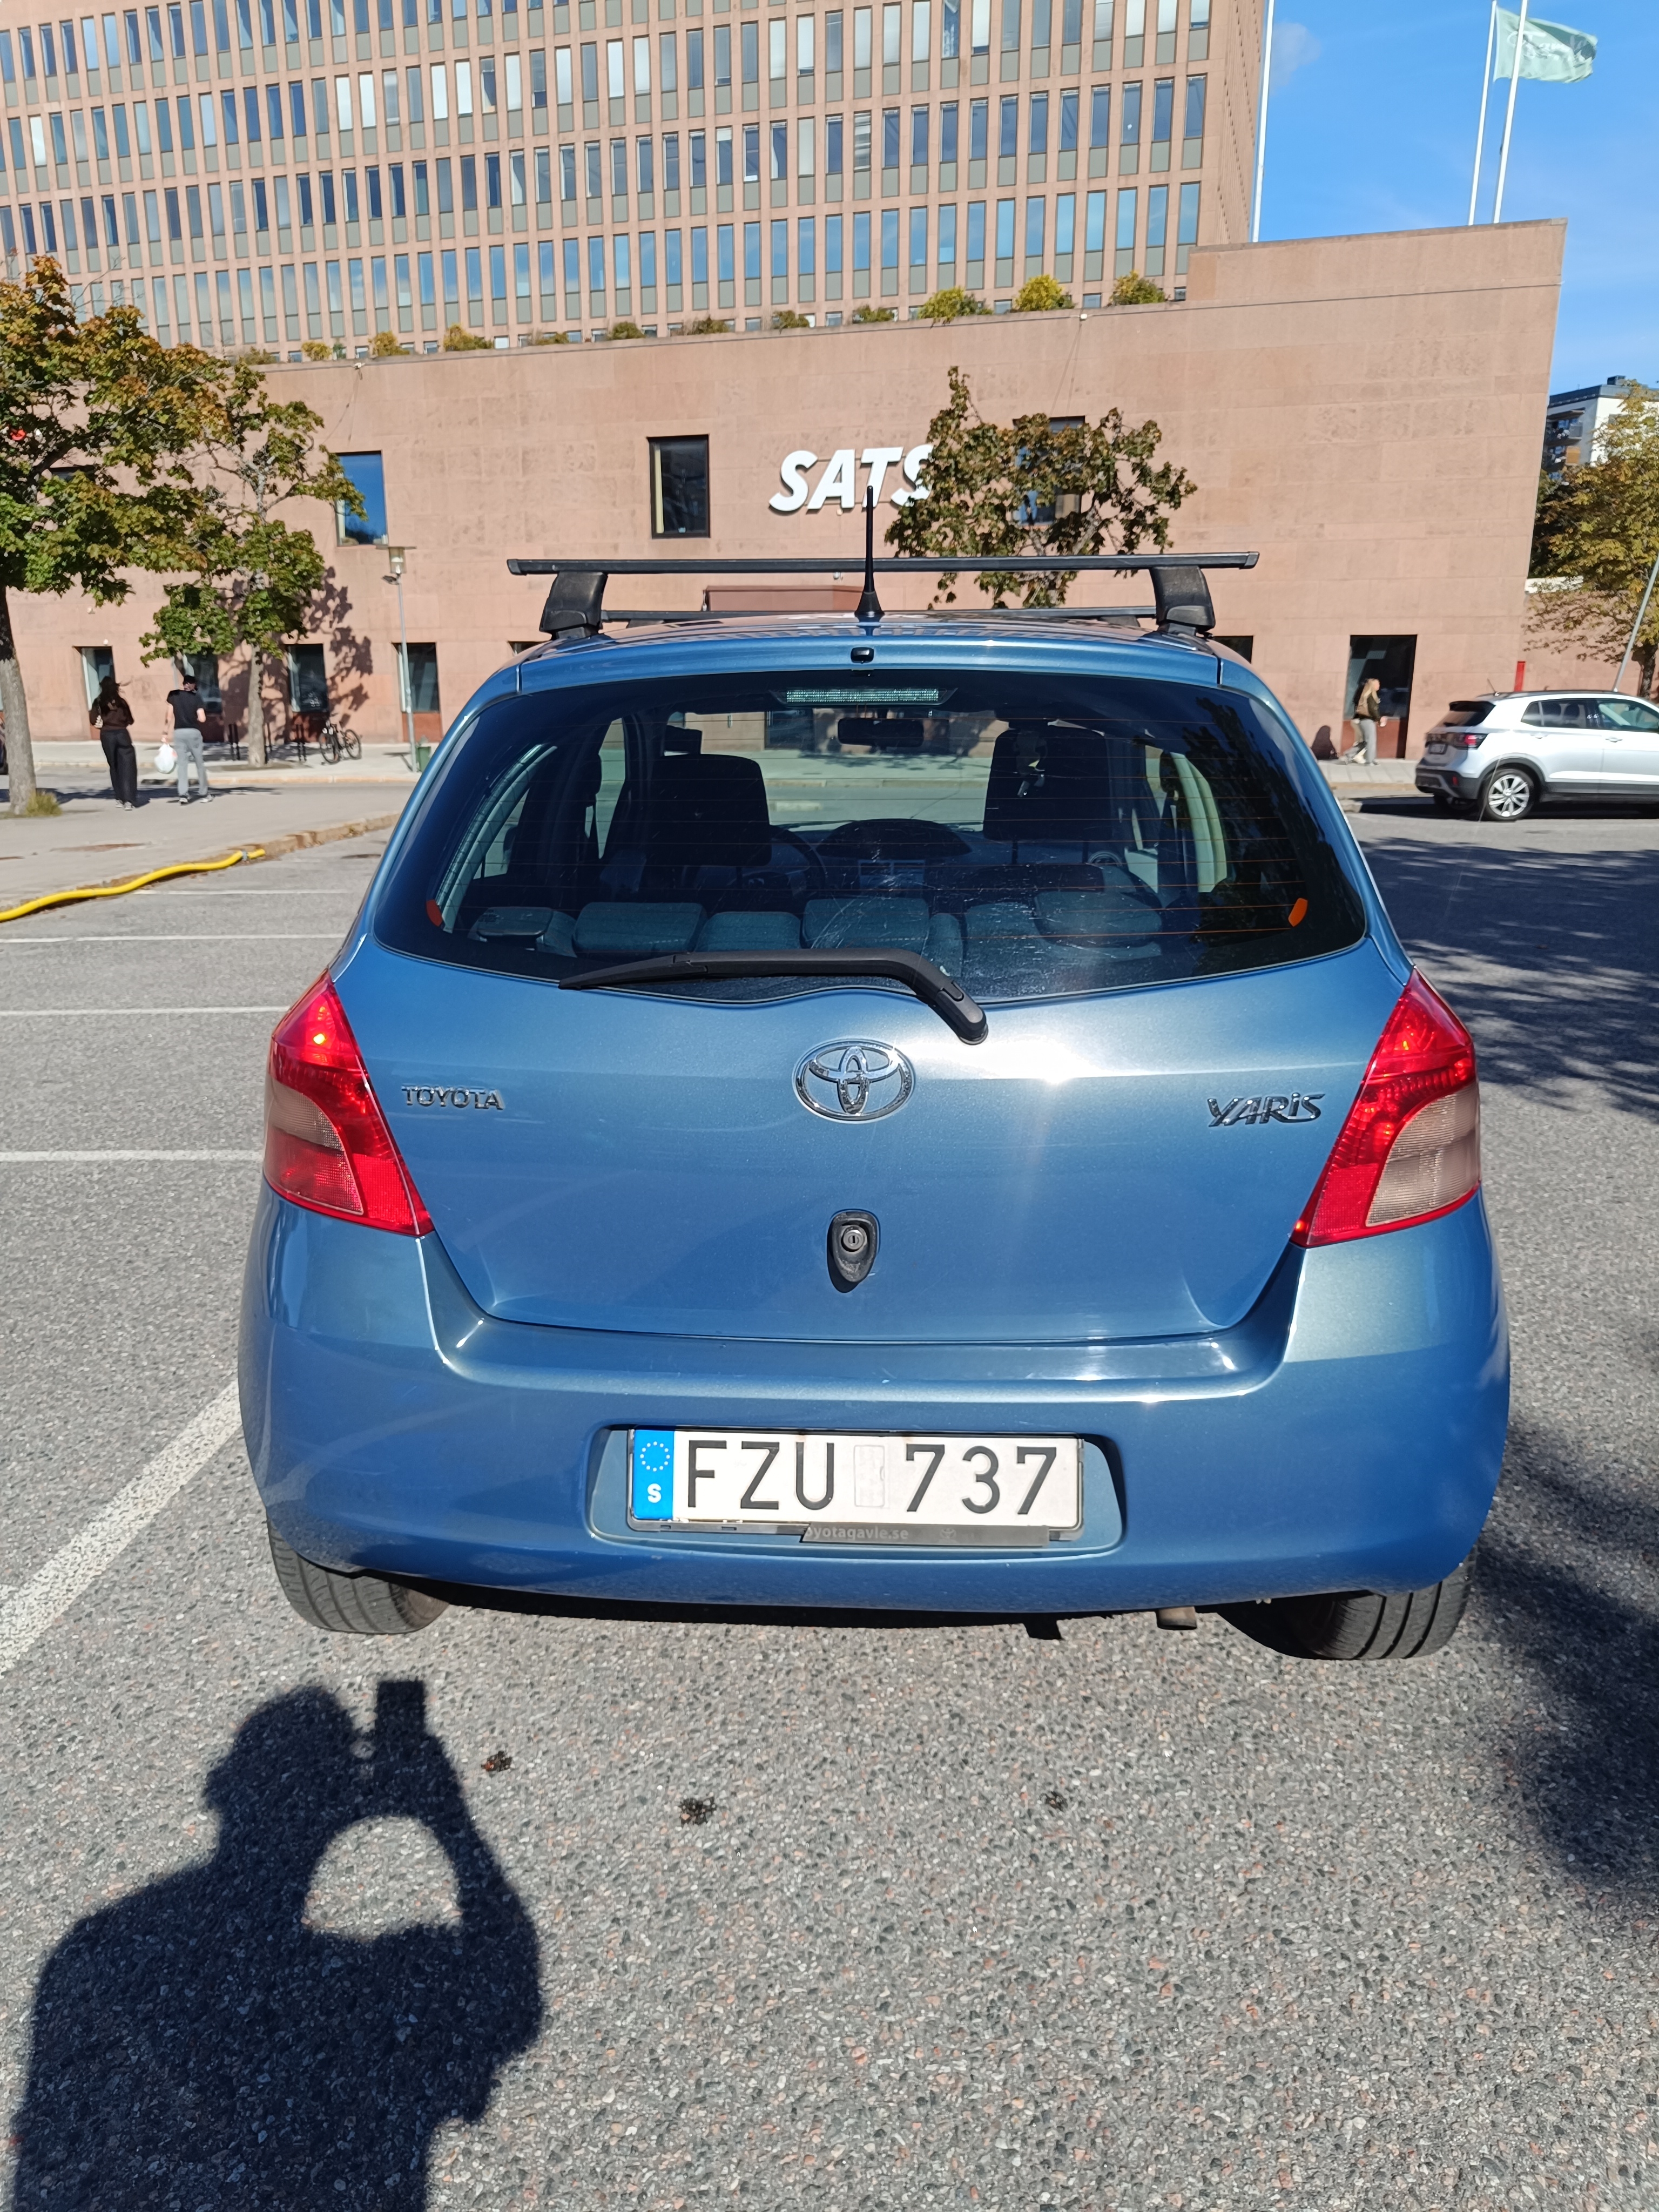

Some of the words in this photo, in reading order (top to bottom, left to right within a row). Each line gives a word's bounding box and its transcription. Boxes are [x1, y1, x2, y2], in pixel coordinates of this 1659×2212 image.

[768, 444, 935, 514] SATS
[401, 1083, 505, 1110] TOYOTA
[647, 1483, 662, 1503] S
[687, 1439, 835, 1510] FZU
[905, 1443, 1057, 1515] 737
